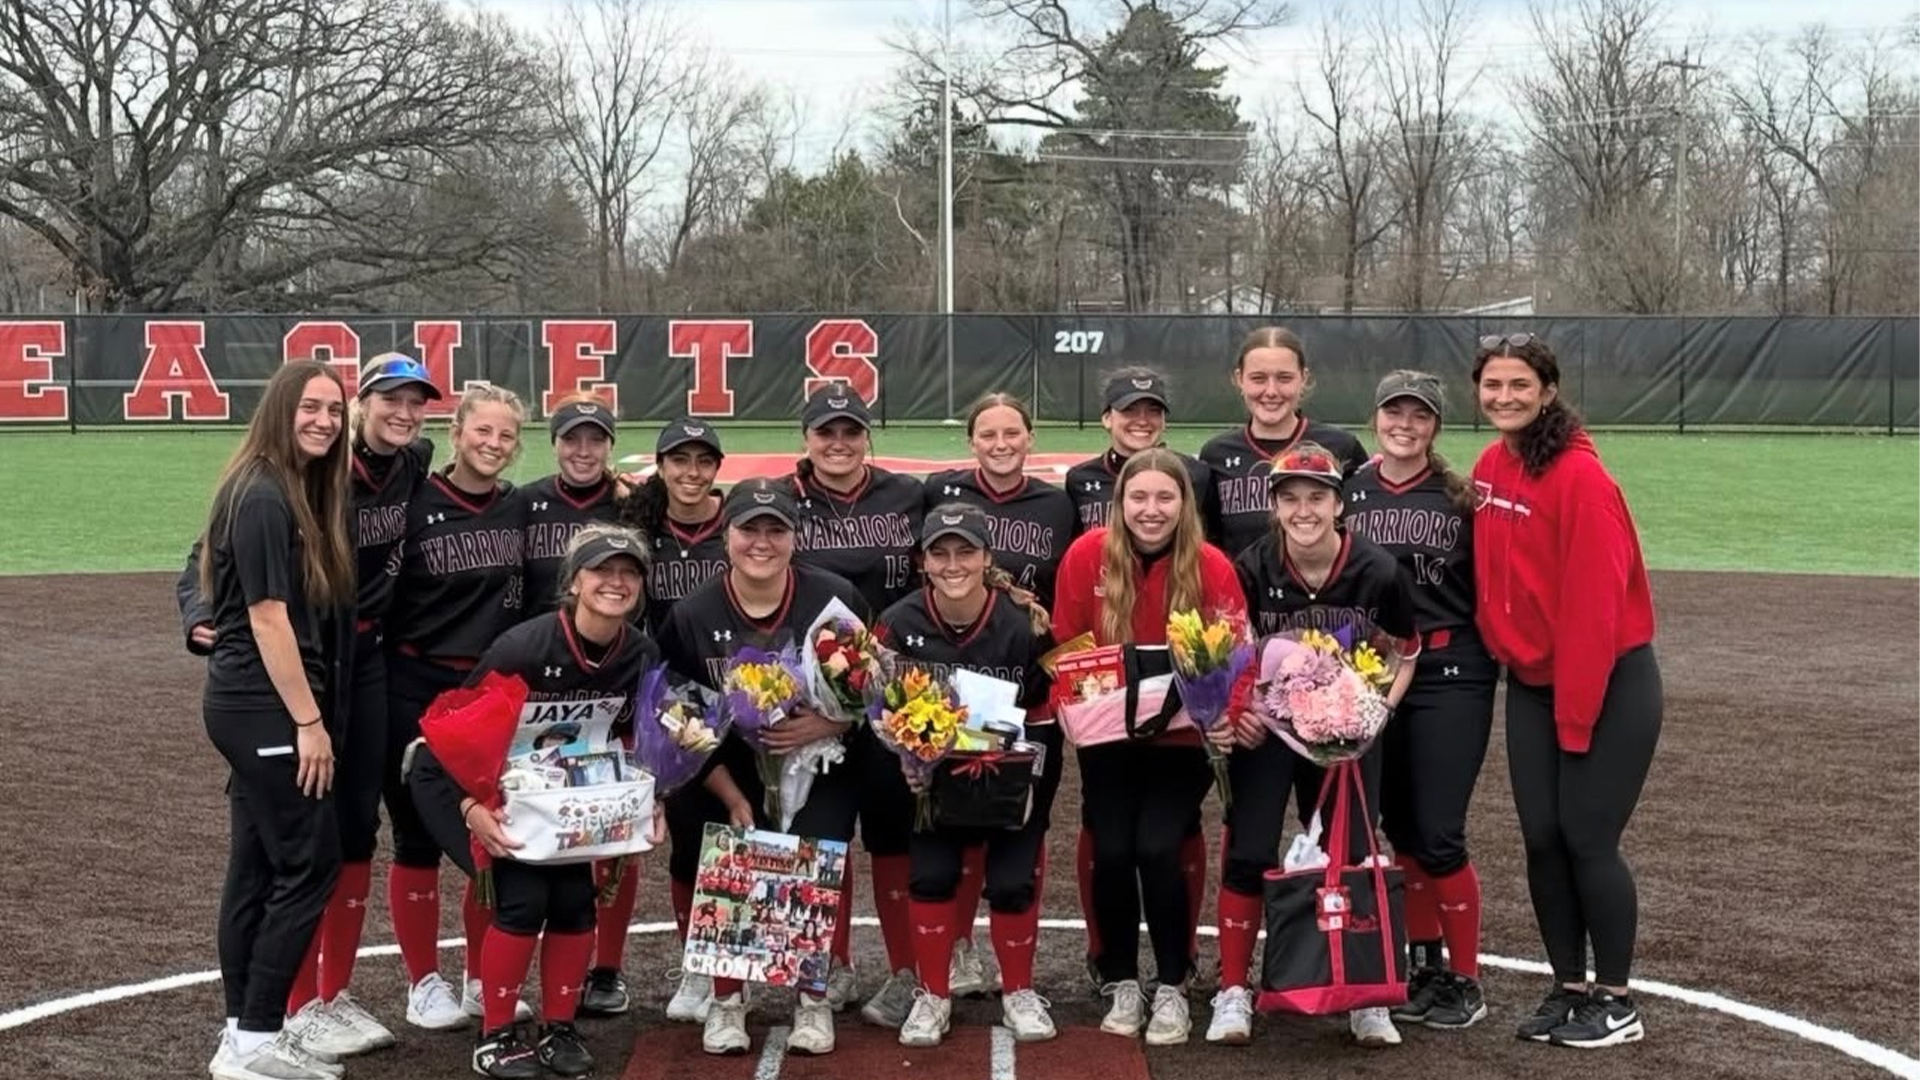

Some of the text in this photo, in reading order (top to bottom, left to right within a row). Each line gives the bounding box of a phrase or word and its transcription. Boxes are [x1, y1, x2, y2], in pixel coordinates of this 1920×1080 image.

[1054, 330, 1104, 354] 207
[984, 514, 1054, 560] RIORS
[884, 555, 911, 589] 15
[1413, 553, 1446, 585] 16
[526, 703, 595, 725] JAYA
[684, 954, 768, 982] CRONK
